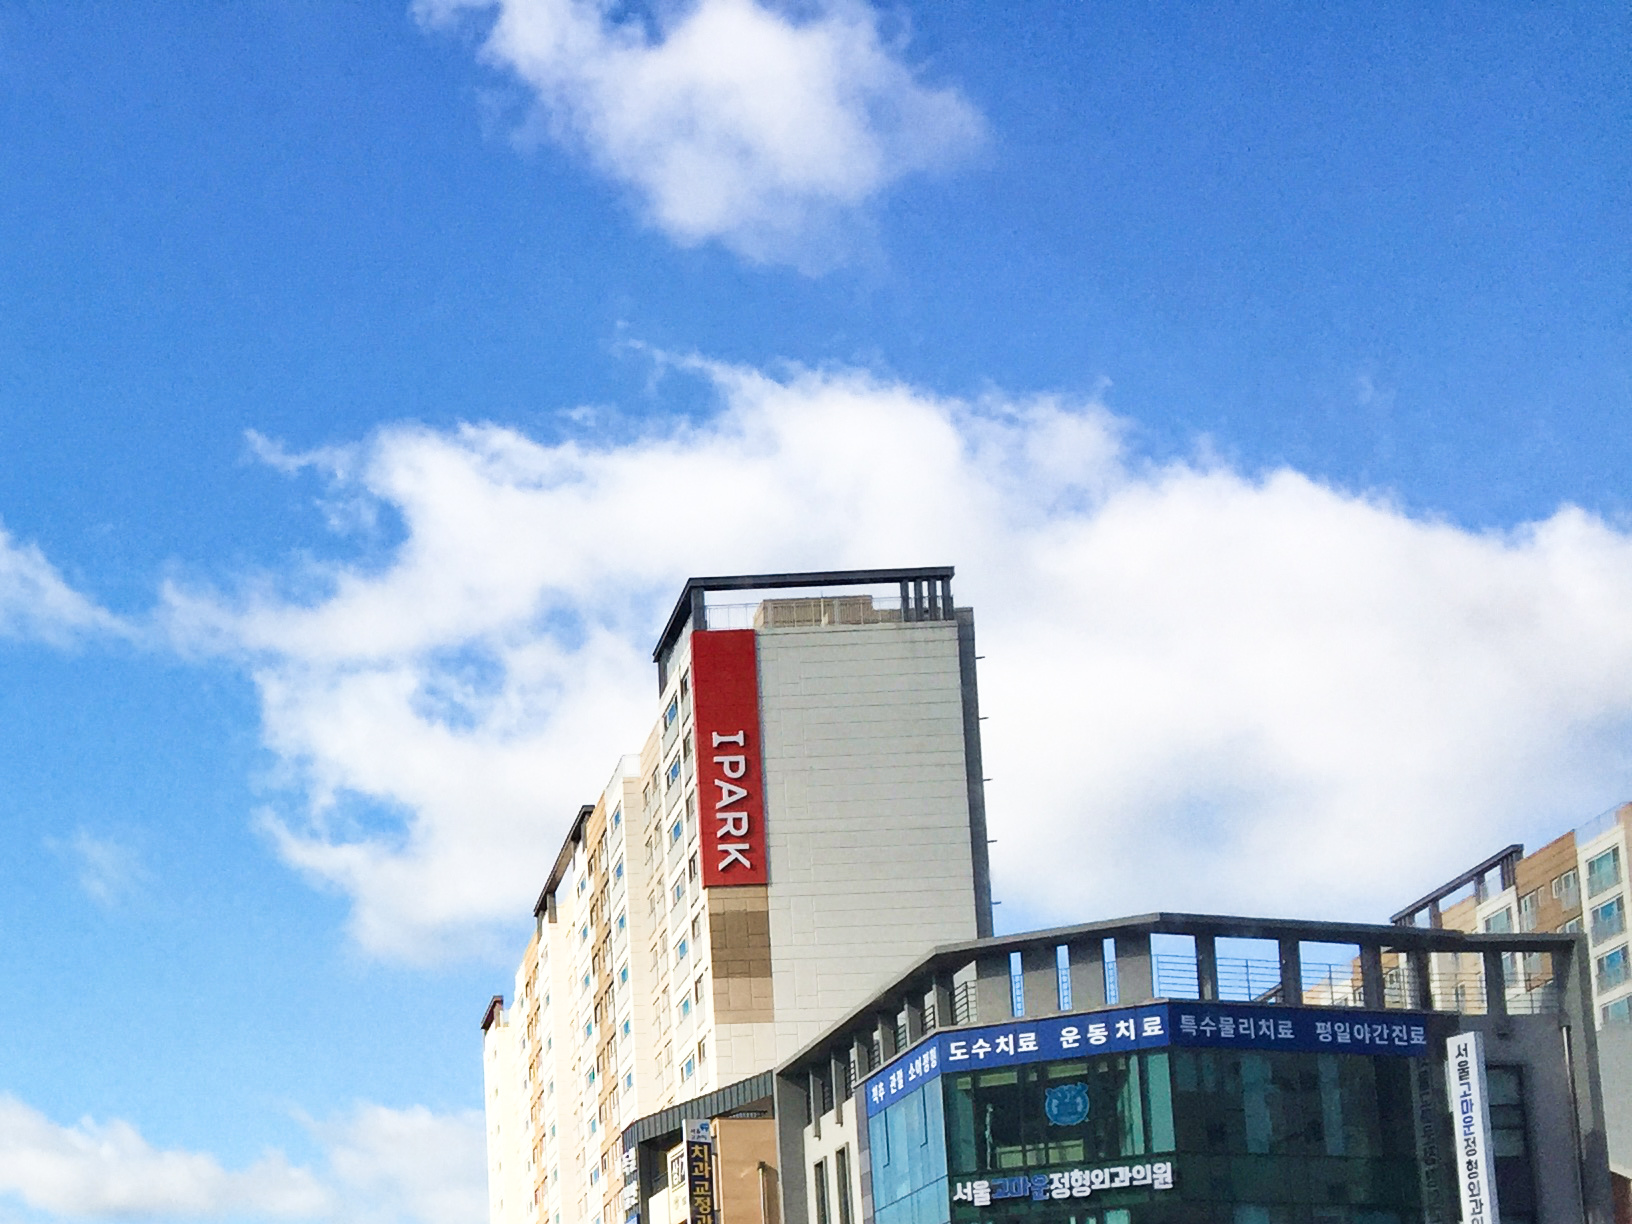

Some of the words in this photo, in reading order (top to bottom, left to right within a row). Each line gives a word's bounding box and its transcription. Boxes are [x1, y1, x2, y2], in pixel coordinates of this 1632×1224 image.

[711, 730, 751, 871] IPARK
[948, 1032, 1039, 1062] 도수치료
[1059, 1016, 1165, 1049] 운동치료
[1179, 1014, 1296, 1040] 특수물리치료
[1315, 1021, 1428, 1046] 평일야간진료
[953, 1161, 1174, 1207] 서울고마운정형외과의원
